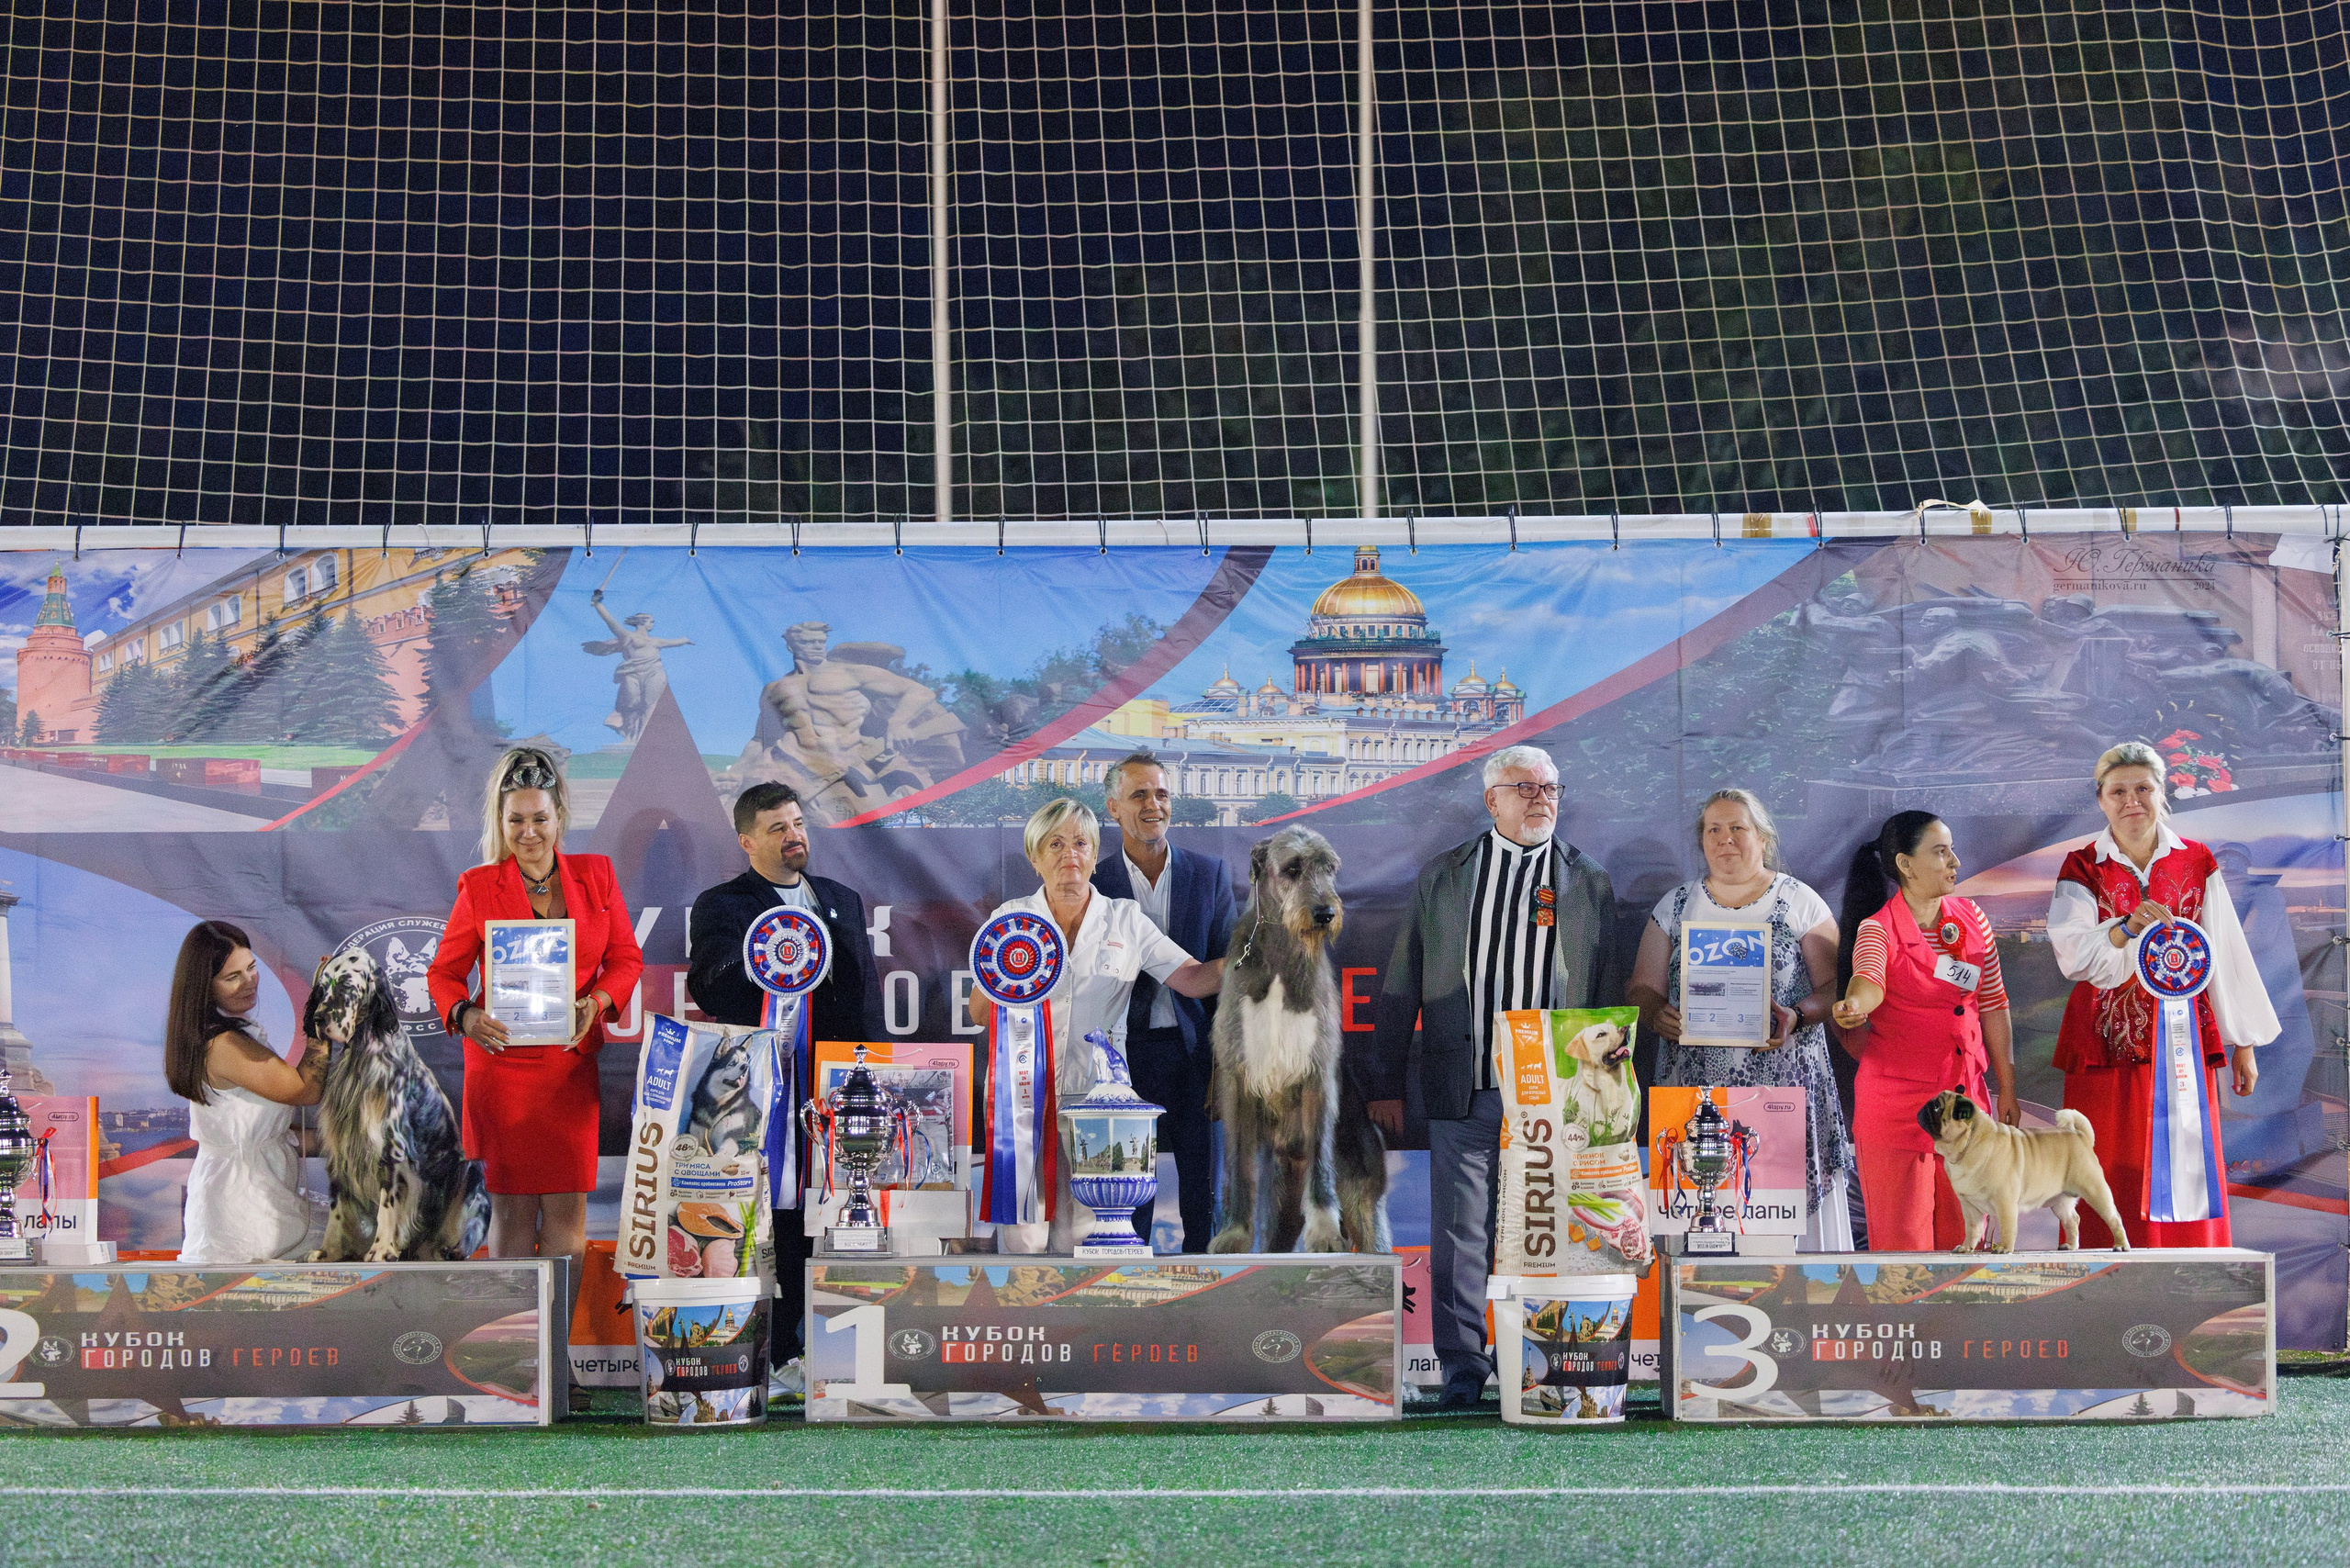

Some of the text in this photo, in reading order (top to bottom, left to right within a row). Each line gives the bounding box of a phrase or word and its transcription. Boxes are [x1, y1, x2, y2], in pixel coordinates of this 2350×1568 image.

[1688, 931, 1764, 966] OZON
[1946, 965, 1972, 984] 514
[513, 1012, 520, 1021] 2
[542, 1011, 548, 1021] 3
[1709, 1013, 1716, 1023] 2
[1737, 1014, 1744, 1024] 3
[657, 1030, 682, 1044] PREMIUM
[932, 1059, 956, 1069] 4lapy.ru
[646, 1075, 672, 1091] ADULT
[1520, 1074, 1544, 1084] ADULT
[1567, 1134, 1585, 1142] 44%
[675, 1143, 694, 1151] 48%
[629, 1122, 664, 1260] SIRIUS
[1523, 1118, 1556, 1258] SIRIUS
[1741, 1204, 1796, 1219] лапы
[25, 1214, 76, 1229] лапы
[627, 1260, 656, 1271] PREMIUM
[942, 1326, 1045, 1341] КУБОК
[1812, 1323, 1916, 1338] КУБОК
[81, 1331, 185, 1348] КУБОК
[825, 1305, 912, 1399] 1
[946, 1343, 1198, 1364] ГОРОДОВ ГЕРОЕВ
[1562, 1351, 1589, 1361] КУБОК
[1691, 1304, 1779, 1400] 3
[1816, 1338, 2068, 1362] ГОРОДОВ ГЕРОЕВ
[84, 1347, 339, 1370] ГОРОДОВ ГЕРОЕВ
[676, 1357, 701, 1366] КУБОК
[574, 1359, 640, 1373] четыре
[677, 1365, 708, 1377] ГОРОДОВ
[1562, 1361, 1594, 1372] ГОРОДОВ
